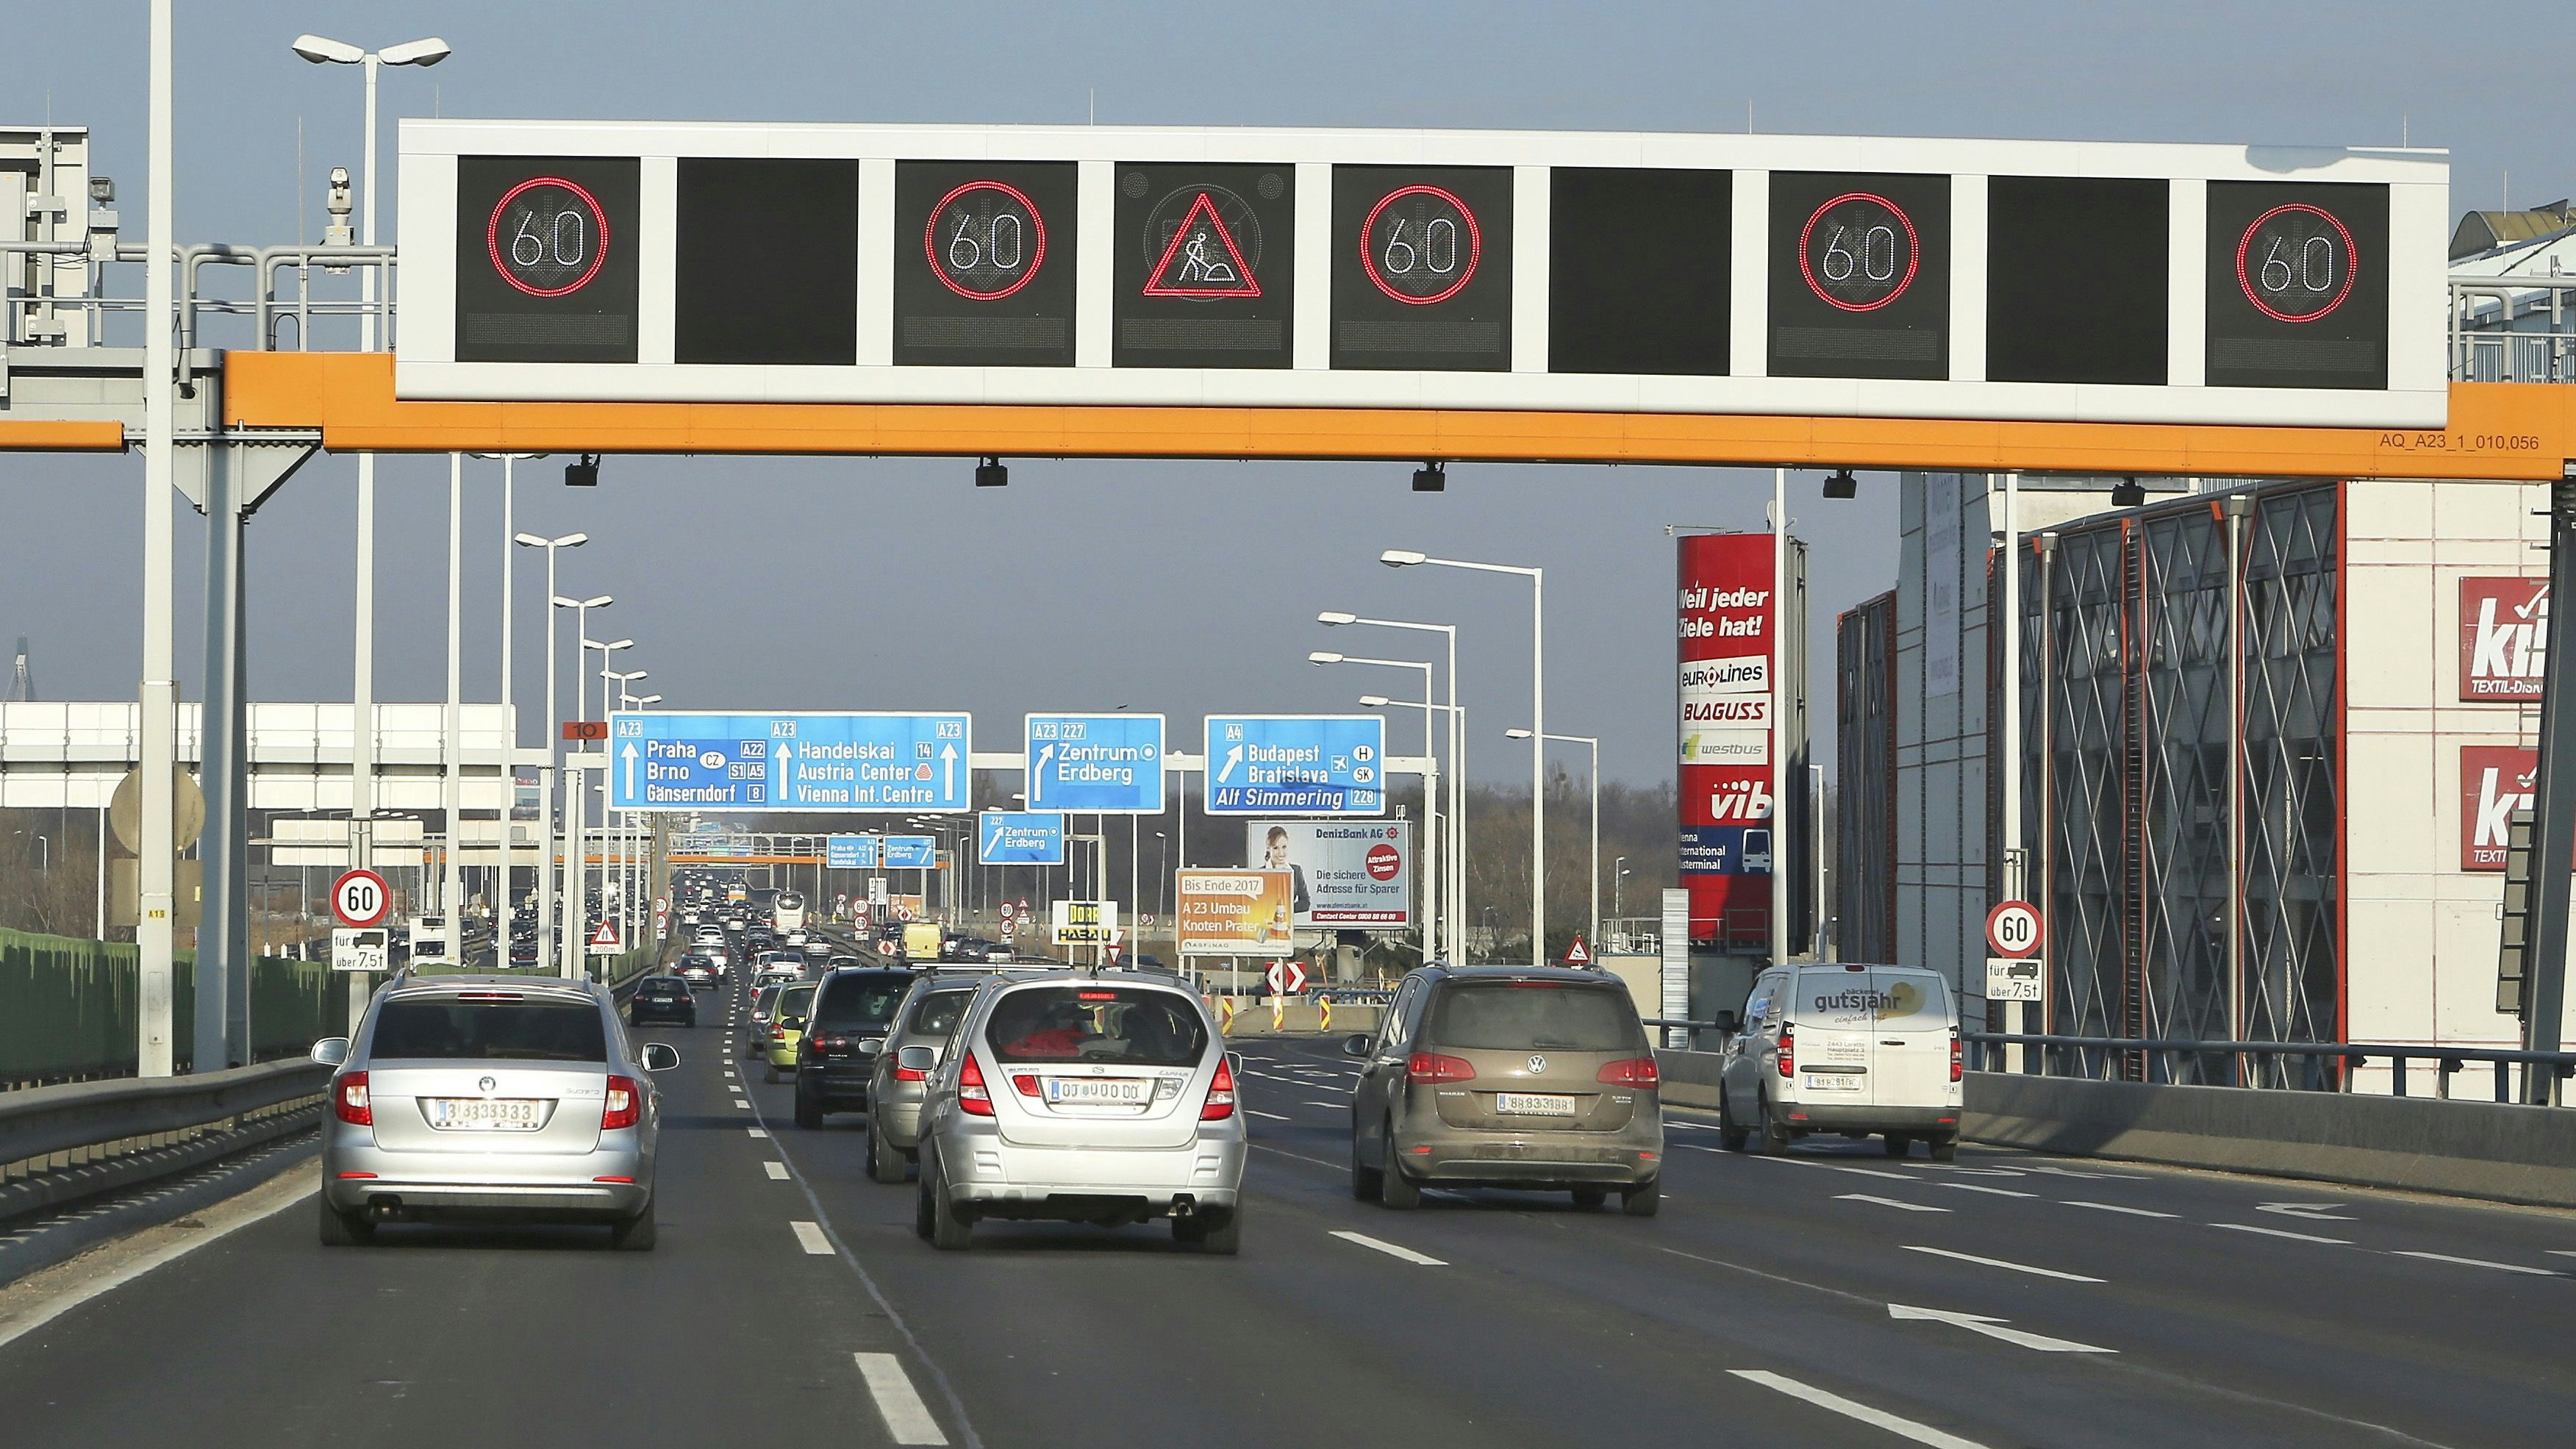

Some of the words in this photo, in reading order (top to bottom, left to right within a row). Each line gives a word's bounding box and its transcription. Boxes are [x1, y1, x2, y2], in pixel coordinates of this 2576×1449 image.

[512, 210, 583, 266] 60
[949, 214, 1020, 269] 60
[1385, 218, 1456, 273] 60
[1822, 226, 1894, 281] 60
[2261, 236, 2332, 291] 60
[2380, 434, 2539, 451] AQ_A23_1_010,056
[1709, 587, 1769, 612] jeder
[1719, 615, 1763, 636] hat!
[1684, 702, 1765, 720] BLAGUSS
[619, 722, 641, 736] A23
[773, 723, 795, 736] A23
[938, 723, 960, 737] A23
[1034, 724, 1056, 737] A23
[1063, 724, 1084, 737] 227
[1227, 726, 1242, 740] A4
[647, 740, 697, 759] Praha
[743, 743, 764, 756] A22
[798, 741, 895, 759] Handelskai
[918, 744, 931, 757] 14
[1058, 743, 1138, 761] Zentrum
[1248, 744, 1319, 766] Budapest
[1359, 748, 1367, 759] H
[1702, 745, 1763, 754] westbus
[706, 754, 719, 765] CZ
[647, 762, 690, 780] Brno
[731, 765, 745, 777] S1
[749, 765, 764, 777] A5
[797, 763, 854, 781] Austria
[861, 763, 912, 781] Center
[1059, 763, 1132, 785] Erdberg
[1248, 765, 1328, 783] Bratislava
[1357, 769, 1370, 780] SK
[647, 784, 736, 802] Gänserndorf
[752, 787, 759, 799] 8
[796, 784, 849, 803] Vienna
[855, 784, 879, 803] Int.
[883, 784, 934, 803] Centre
[1216, 788, 1241, 806] Alt
[1245, 788, 1344, 809] Simmering
[1353, 790, 1374, 804] 228
[1711, 781, 1772, 819] vib
[1005, 826, 1048, 837] Zentrum
[1316, 829, 1367, 838] DenizBank
[1370, 829, 1383, 838] AG
[1005, 837, 1045, 850] Erdberg
[1367, 855, 1398, 863] Attraktive
[2474, 850, 2507, 863] TEXTI
[1317, 870, 1331, 879] Die
[1334, 870, 1366, 879] sichere
[1373, 865, 1394, 873] Zinsen
[1185, 879, 1201, 891] Bis
[1205, 879, 1231, 891] Ende
[1235, 880, 1259, 891] 2017
[1317, 884, 1352, 894] Adresse
[1355, 884, 1367, 893] für
[1370, 884, 1400, 895] Sparer
[348, 887, 373, 912] 60
[1183, 903, 1191, 915] A
[1194, 902, 1207, 915] 23
[1211, 903, 1250, 915] Umbau
[1183, 920, 1222, 931] Knoten
[1226, 920, 1259, 931] Prater
[2003, 917, 2028, 942] 60
[335, 935, 350, 947] für
[337, 957, 356, 967] über
[358, 952, 384, 968] 7,5t
[1989, 964, 2005, 976] für
[1991, 986, 2011, 997] über
[2013, 982, 2037, 998] 7,5t
[1814, 992, 1901, 1012] gutsjahr
